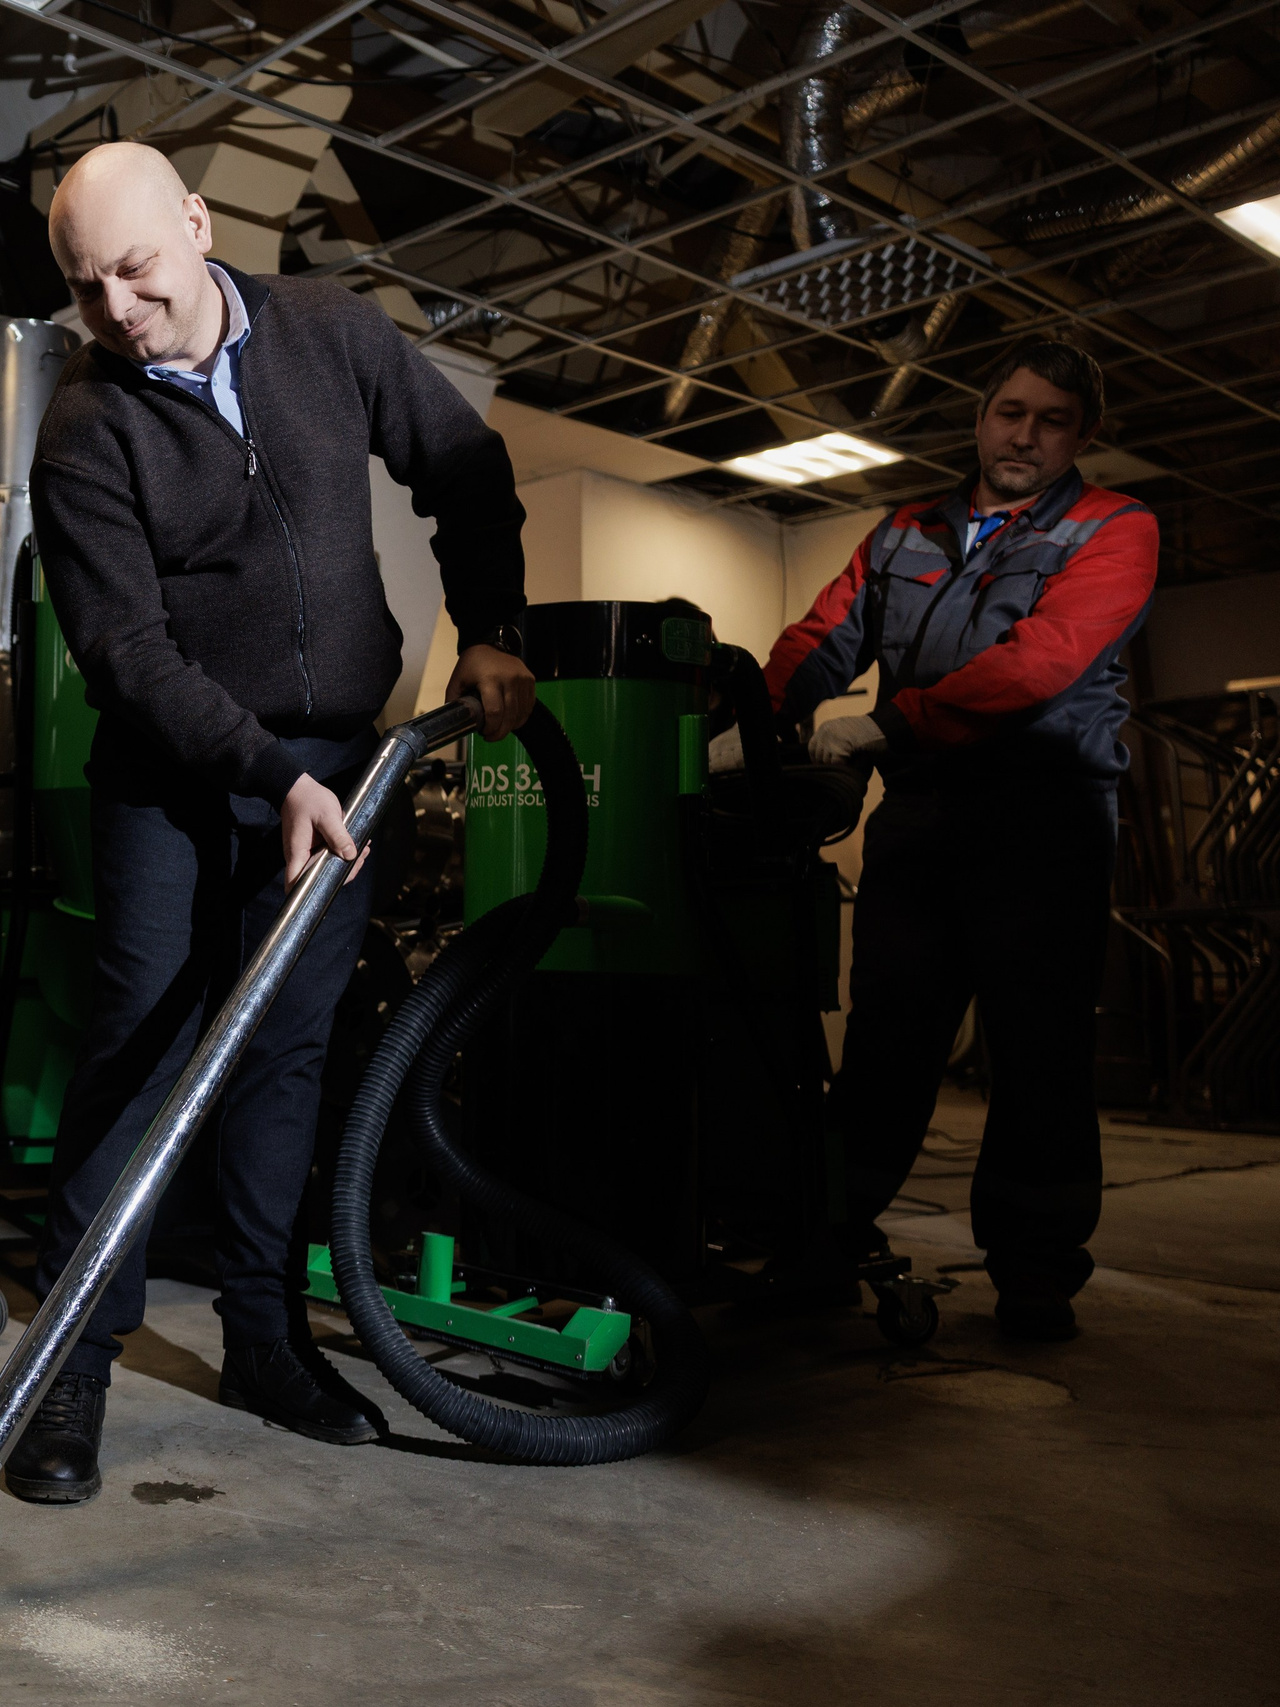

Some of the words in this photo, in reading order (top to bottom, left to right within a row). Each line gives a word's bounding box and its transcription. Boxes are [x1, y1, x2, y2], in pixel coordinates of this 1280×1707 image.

[471, 764, 509, 794] ADS
[470, 796, 486, 809] ANTI
[487, 794, 514, 808] DUST
